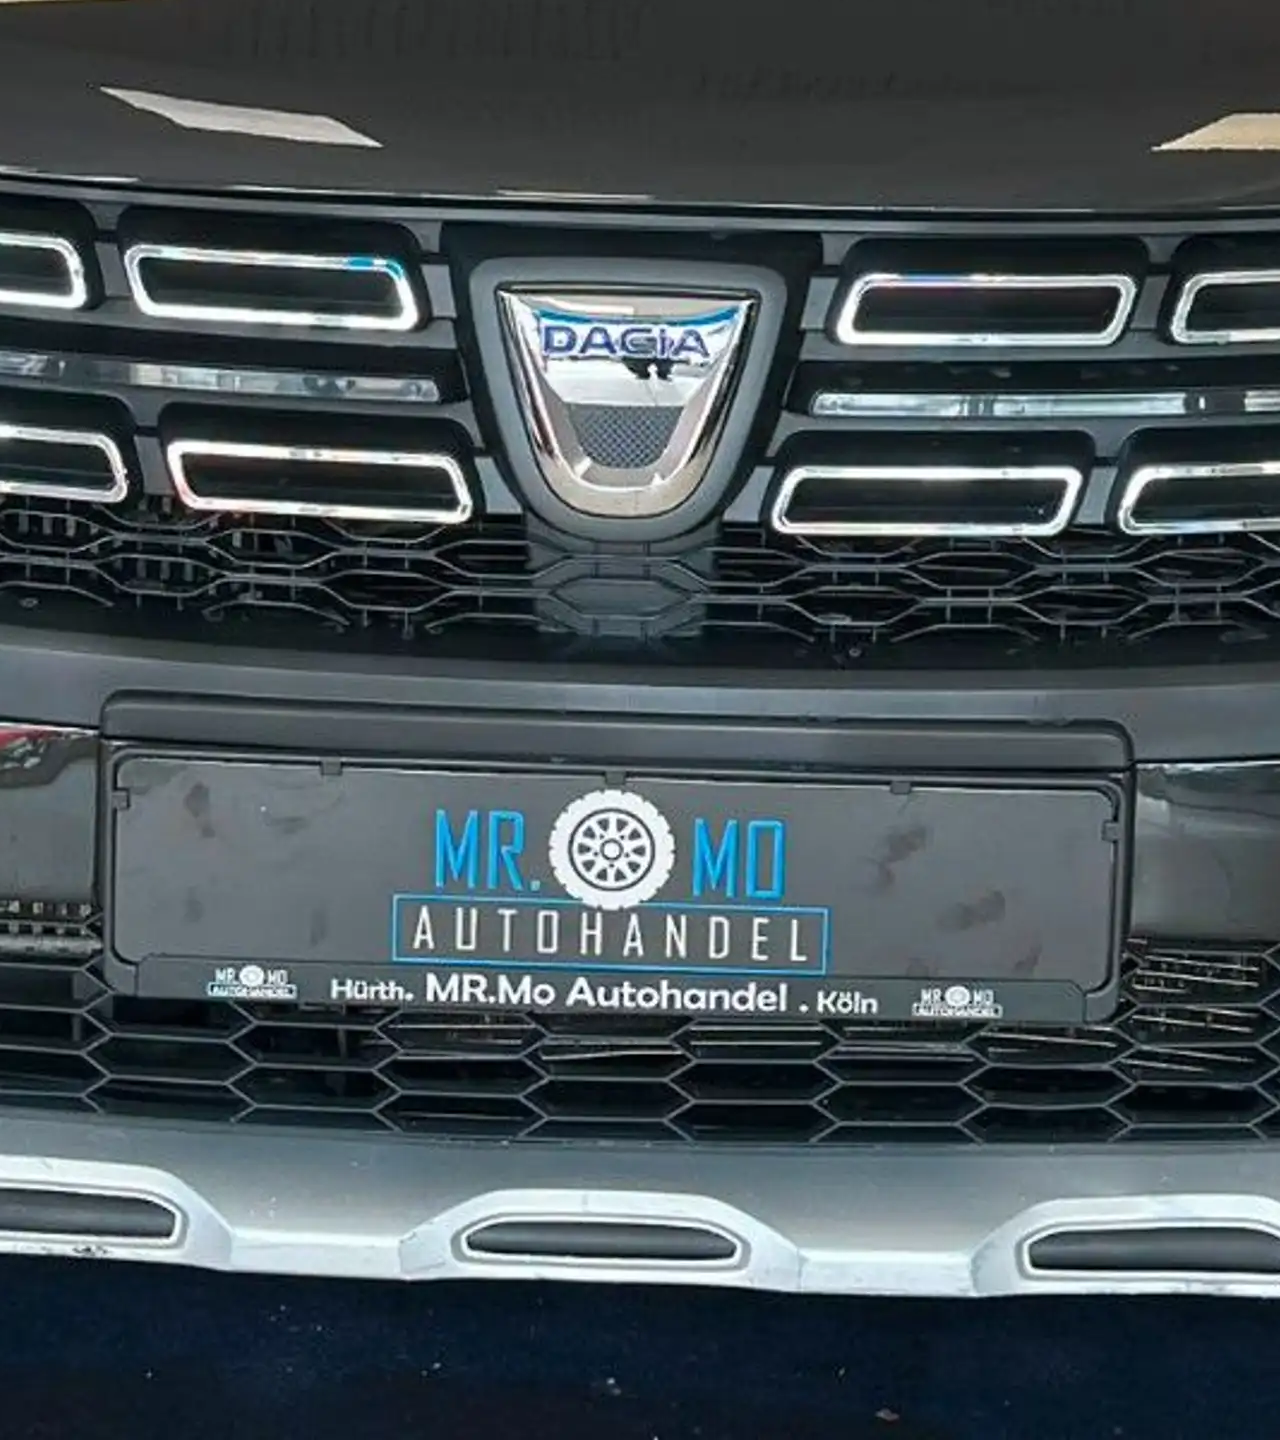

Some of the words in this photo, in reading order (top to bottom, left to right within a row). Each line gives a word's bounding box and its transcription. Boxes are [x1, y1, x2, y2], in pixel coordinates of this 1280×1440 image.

[543, 325, 710, 359] DACIA
[435, 809, 541, 892] MR.
[691, 818, 786, 900] MO
[412, 904, 808, 963] AUTOHANDEL
[425, 971, 556, 1006] MR.Mo
[566, 976, 787, 1012] Autohandel
[818, 990, 878, 1015] Köln
